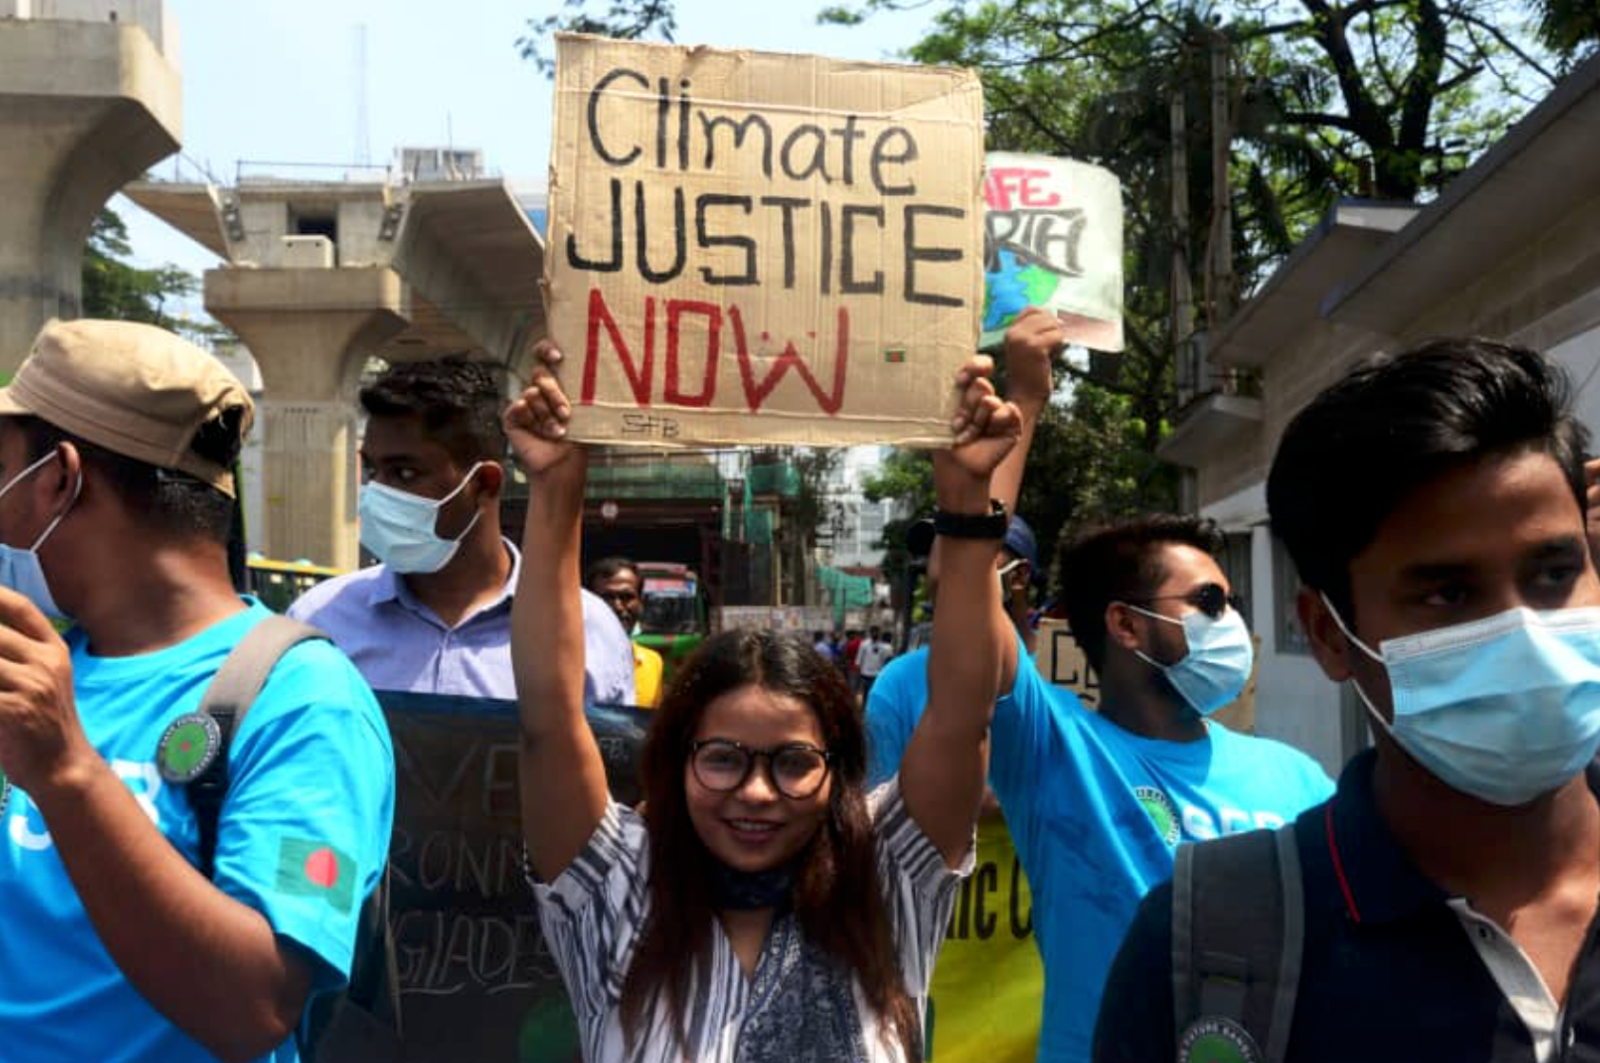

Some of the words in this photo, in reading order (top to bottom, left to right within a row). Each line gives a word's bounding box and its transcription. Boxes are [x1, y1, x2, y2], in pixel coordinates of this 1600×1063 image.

[587, 68, 919, 196] Climate
[566, 178, 966, 307] JUSTICE
[579, 288, 849, 417] NOW
